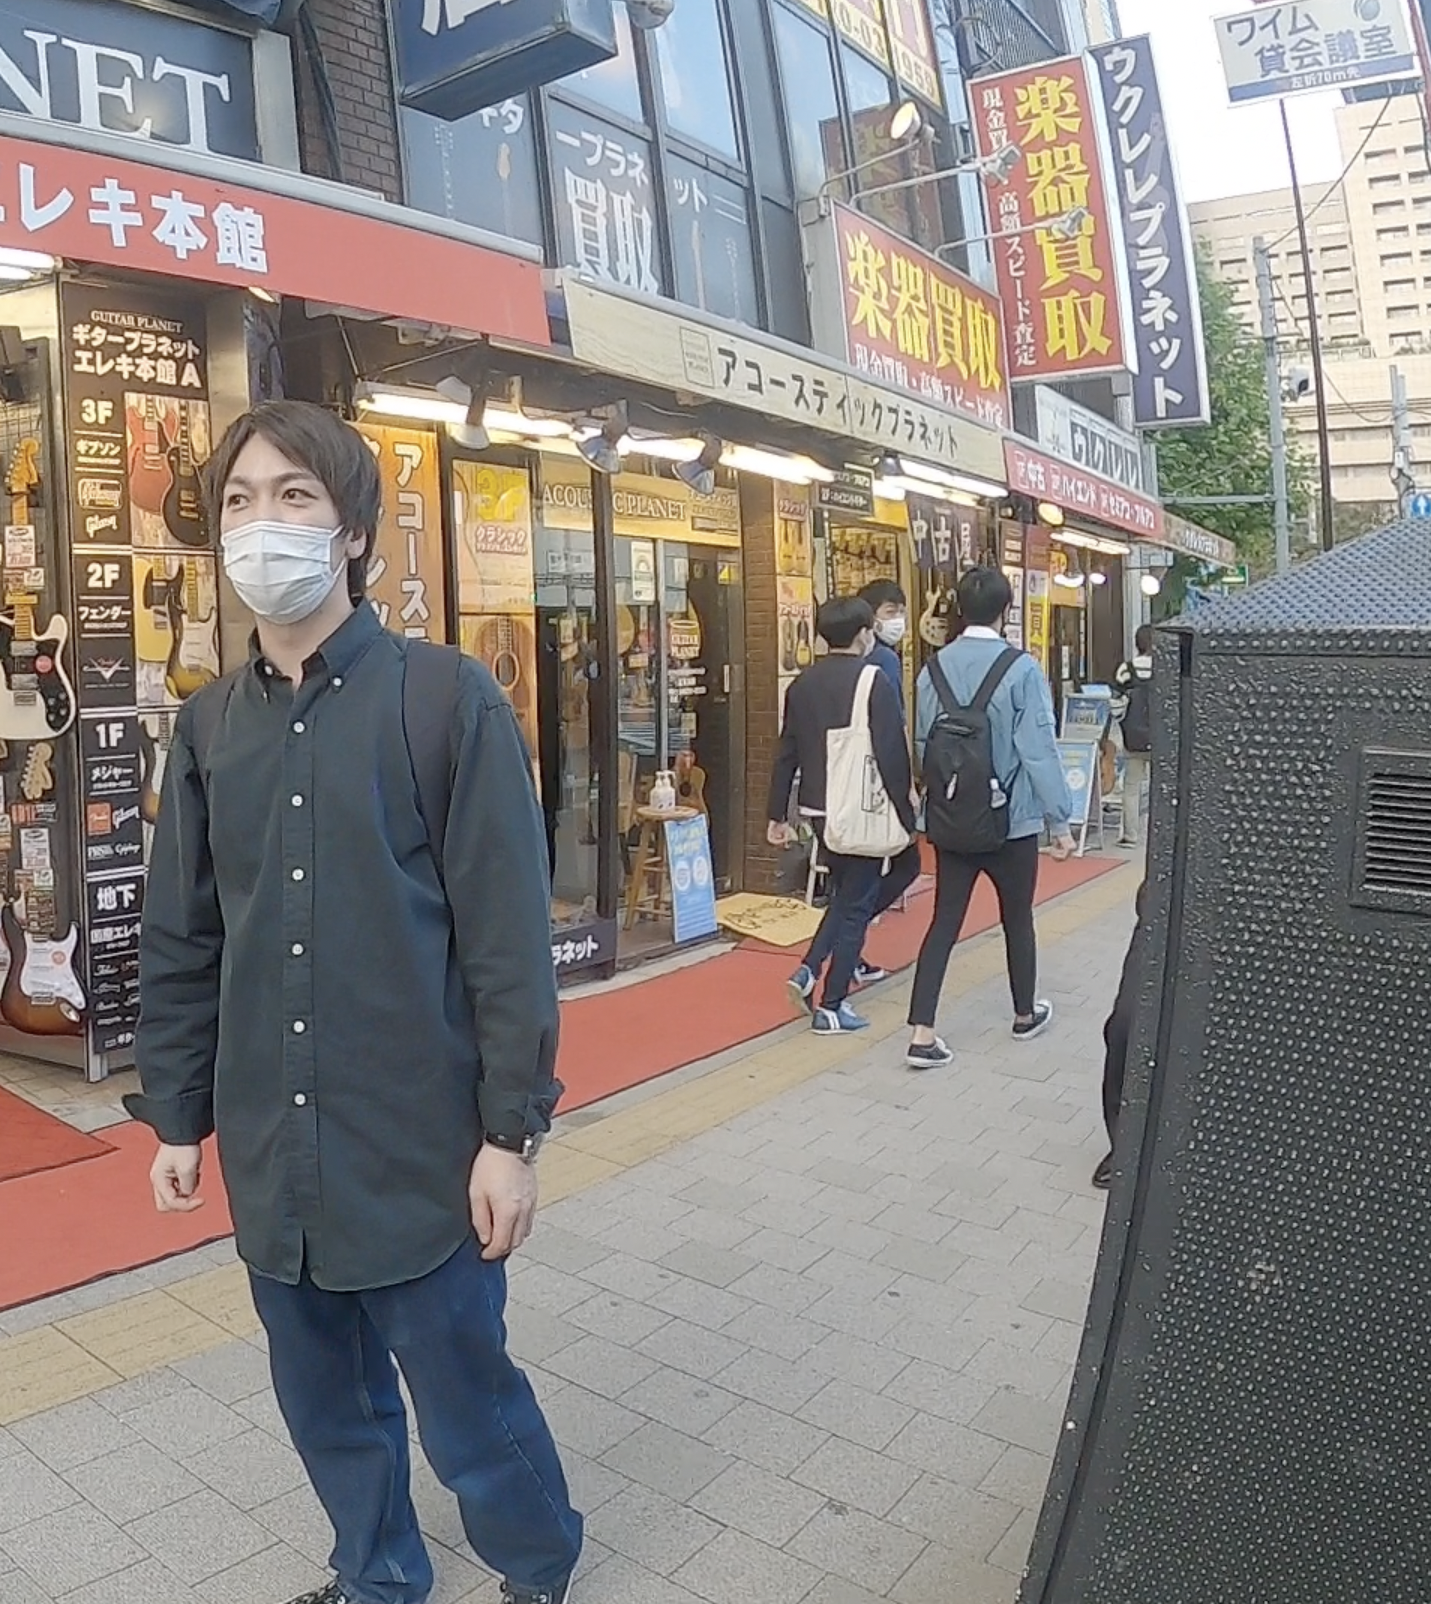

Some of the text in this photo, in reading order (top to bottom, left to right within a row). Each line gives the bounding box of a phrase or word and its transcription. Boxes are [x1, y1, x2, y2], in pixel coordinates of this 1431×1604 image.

[1226, 6, 1319, 46] ワイム
[1255, 25, 1397, 78] 貸会議室
[565, 167, 659, 296] 買取
[1014, 76, 1112, 361] 楽器買取
[1102, 46, 1183, 418] ウクレレプラネット
[90, 310, 183, 333] GUITAR PLANET
[845, 230, 1002, 393] 楽器買取
[72, 323, 201, 360] ギタープラネット
[72, 349, 203, 389] エレキ本館 A
[81, 398, 114, 424] 3F
[717, 346, 960, 457] アコースティックプラネット
[627, 493, 687, 521] PLANET
[87, 562, 120, 588] 2F
[77, 605, 132, 621] フェンダー
[95, 722, 125, 749] 1F
[96, 883, 137, 912] 地下
